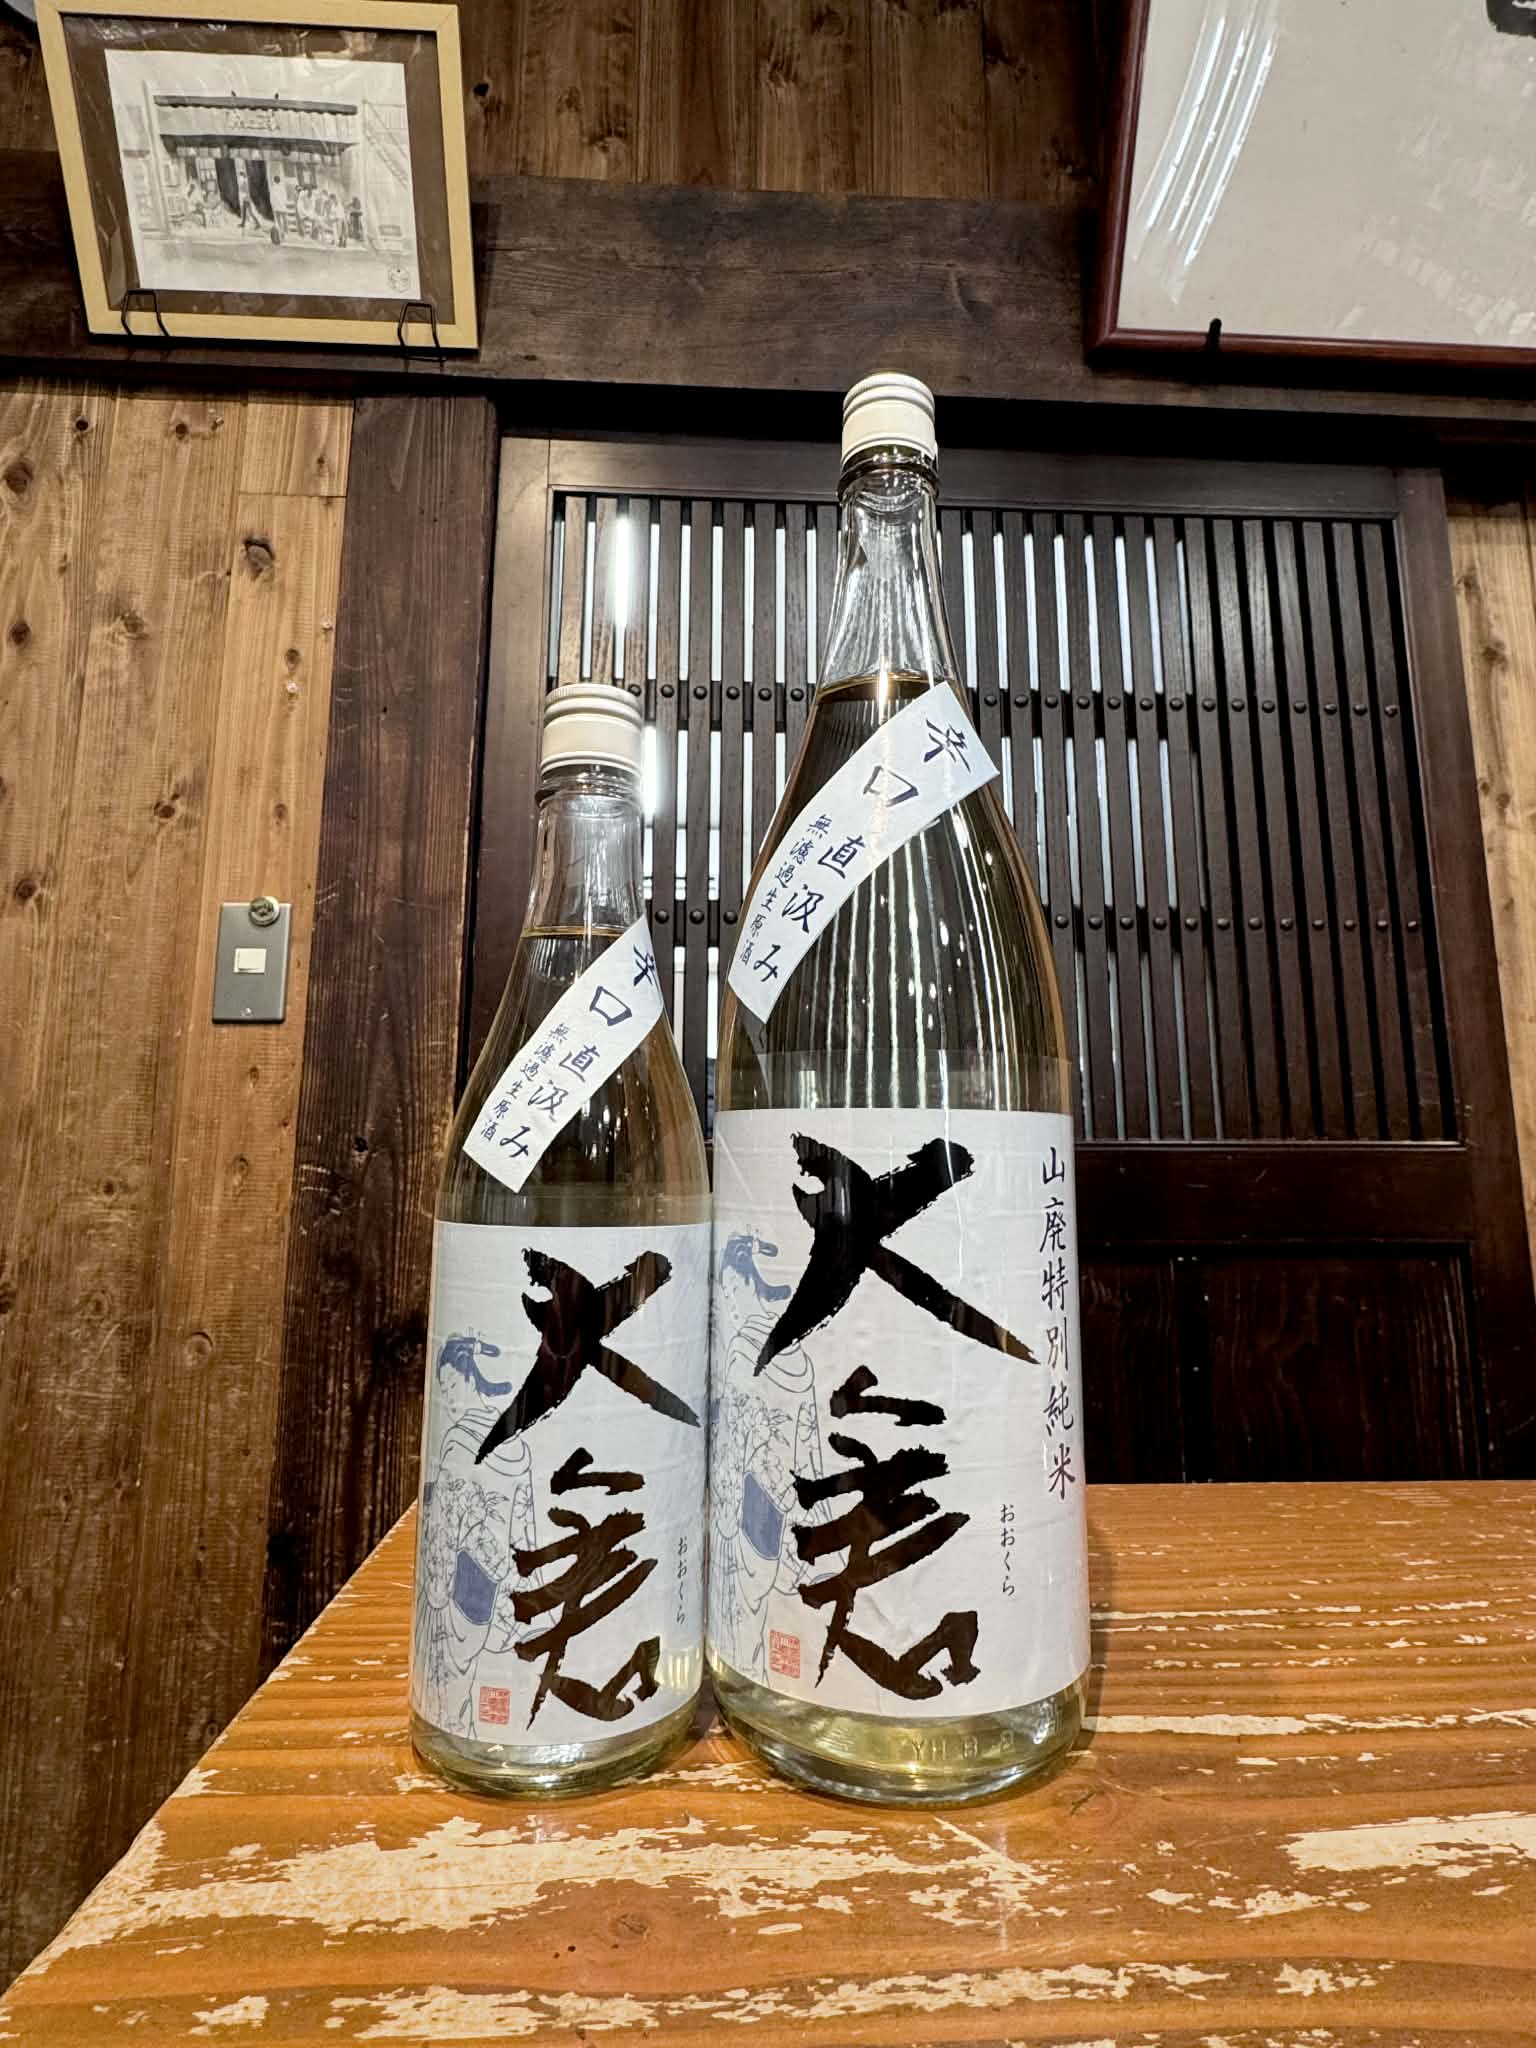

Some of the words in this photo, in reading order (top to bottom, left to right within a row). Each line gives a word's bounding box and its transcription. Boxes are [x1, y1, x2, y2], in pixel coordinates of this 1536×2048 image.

[1039, 1146, 1076, 1501] 山廃特別純米
[677, 1536, 688, 1625] おおくら
[1000, 1503, 1016, 1597] おおくら
